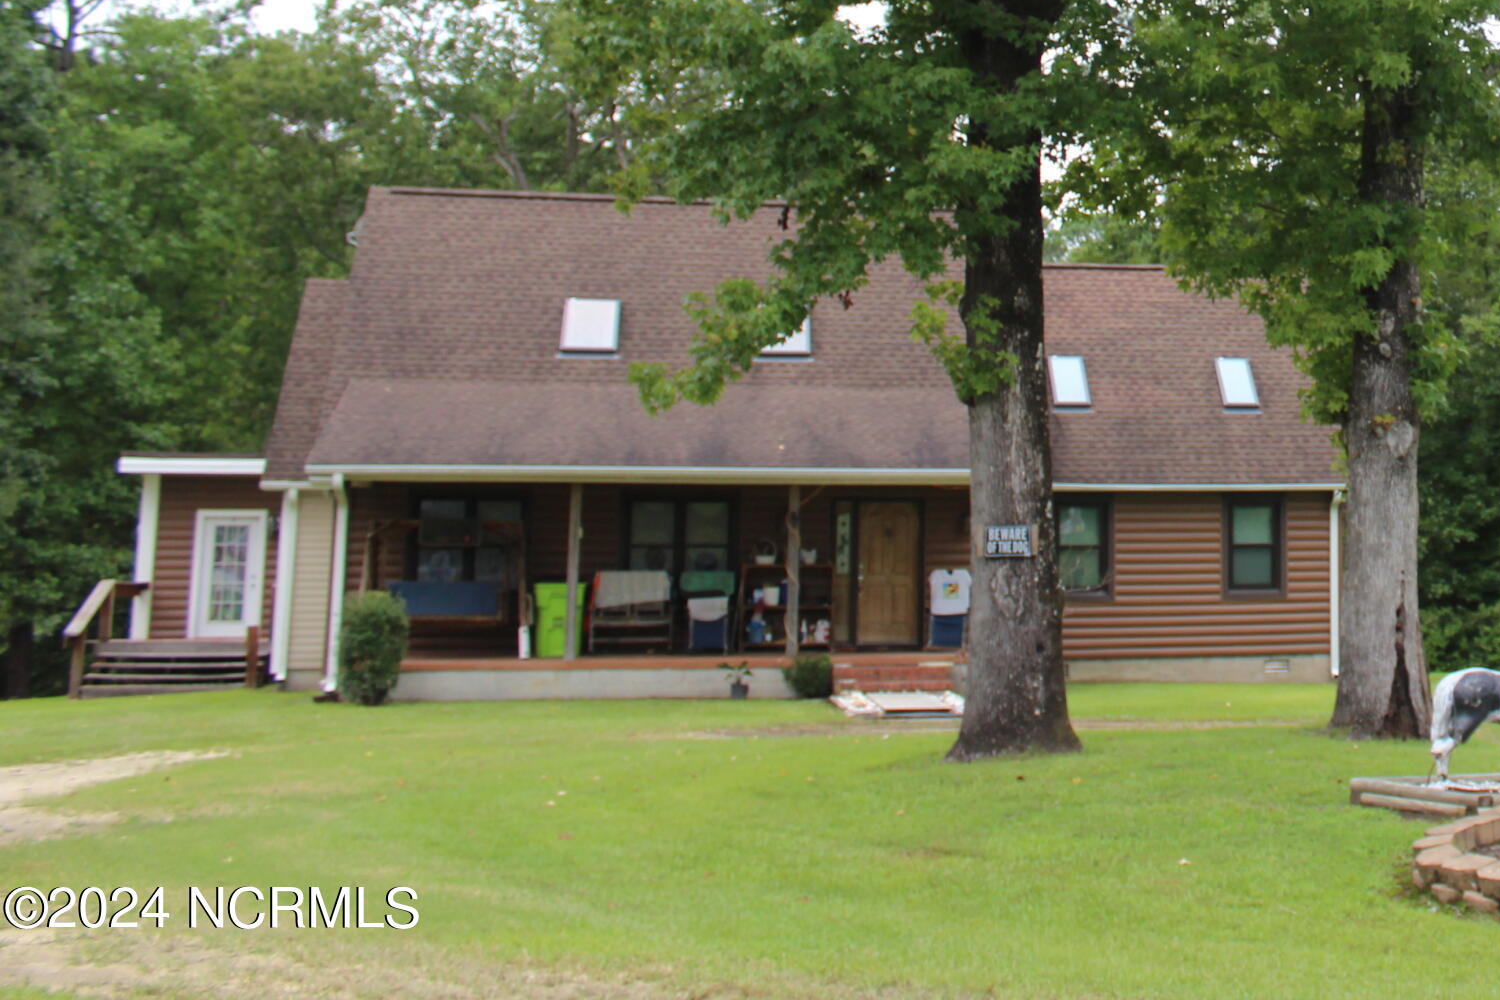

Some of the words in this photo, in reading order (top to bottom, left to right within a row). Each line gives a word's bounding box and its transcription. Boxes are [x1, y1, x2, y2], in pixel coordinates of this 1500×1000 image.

[988, 527, 1027, 540] BEWARE
[987, 540, 996, 553] OF
[998, 540, 1011, 553] THE
